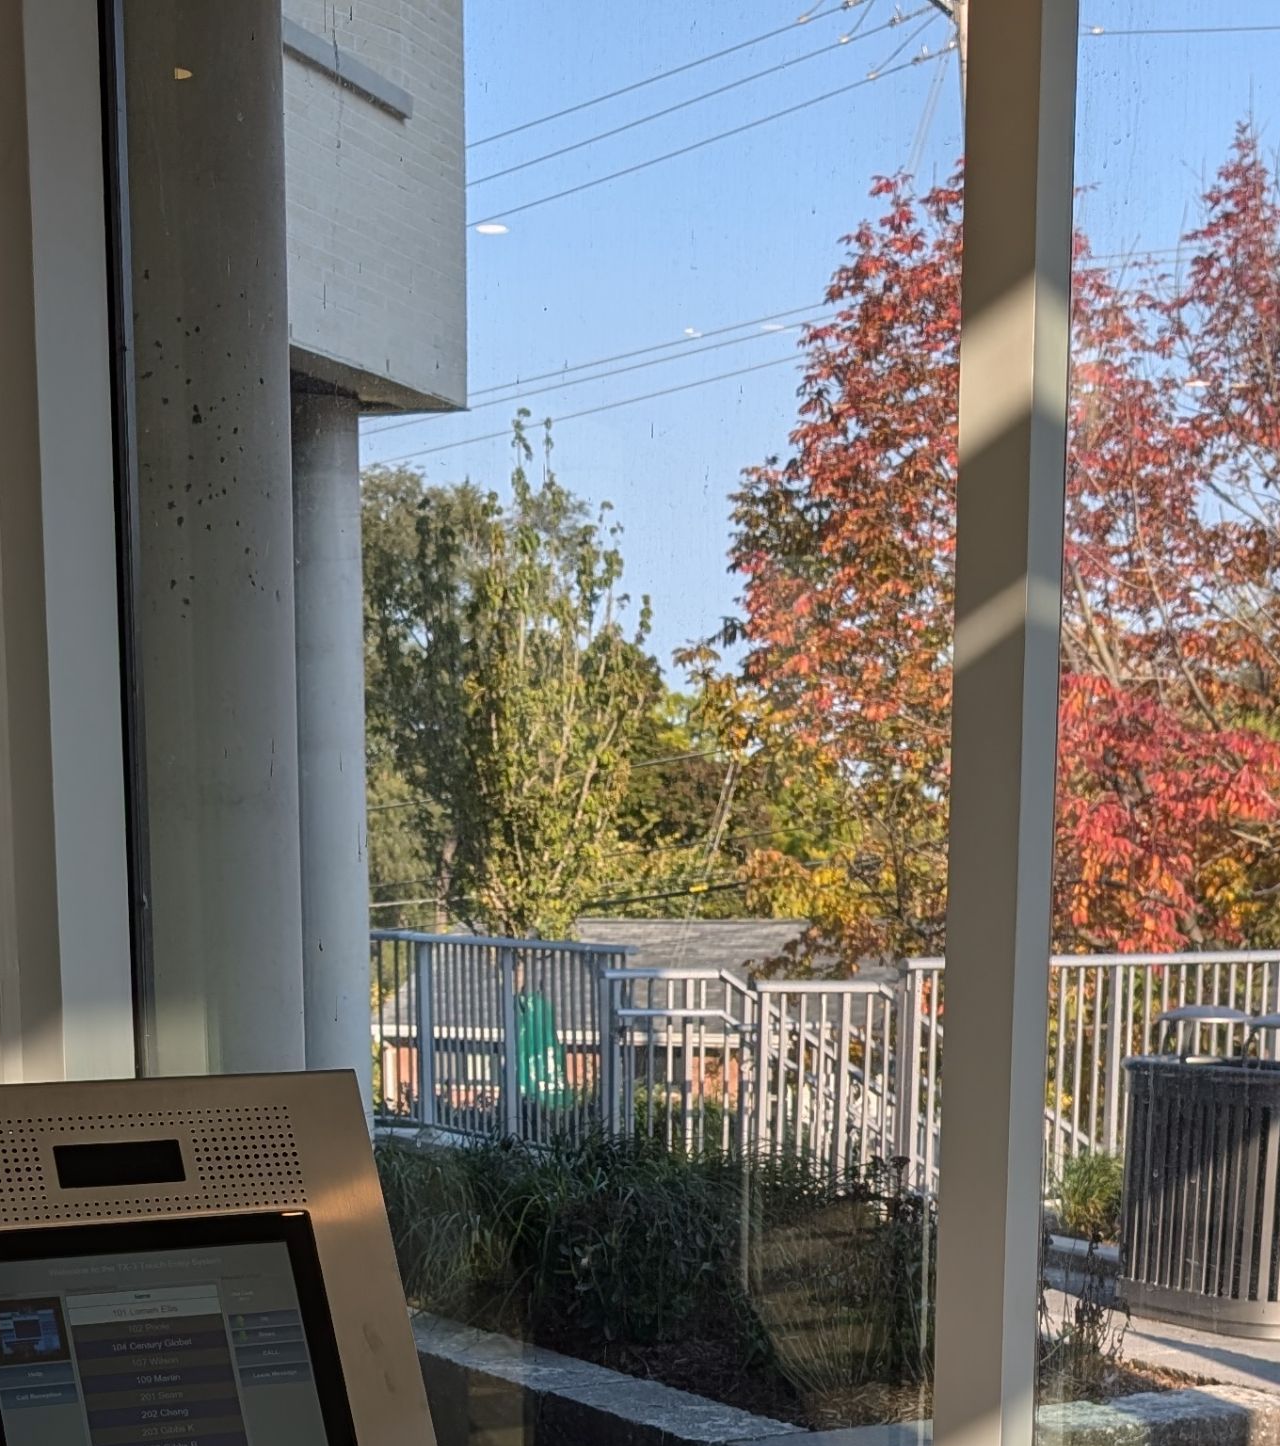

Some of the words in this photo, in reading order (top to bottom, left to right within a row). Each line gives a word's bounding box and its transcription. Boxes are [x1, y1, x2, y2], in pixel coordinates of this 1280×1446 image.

[113, 1308, 127, 1318] 101
[129, 1340, 162, 1351] Century
[164, 1336, 193, 1347] Global
[140, 1409, 158, 1419] 202
[159, 1407, 189, 1418] Chang
